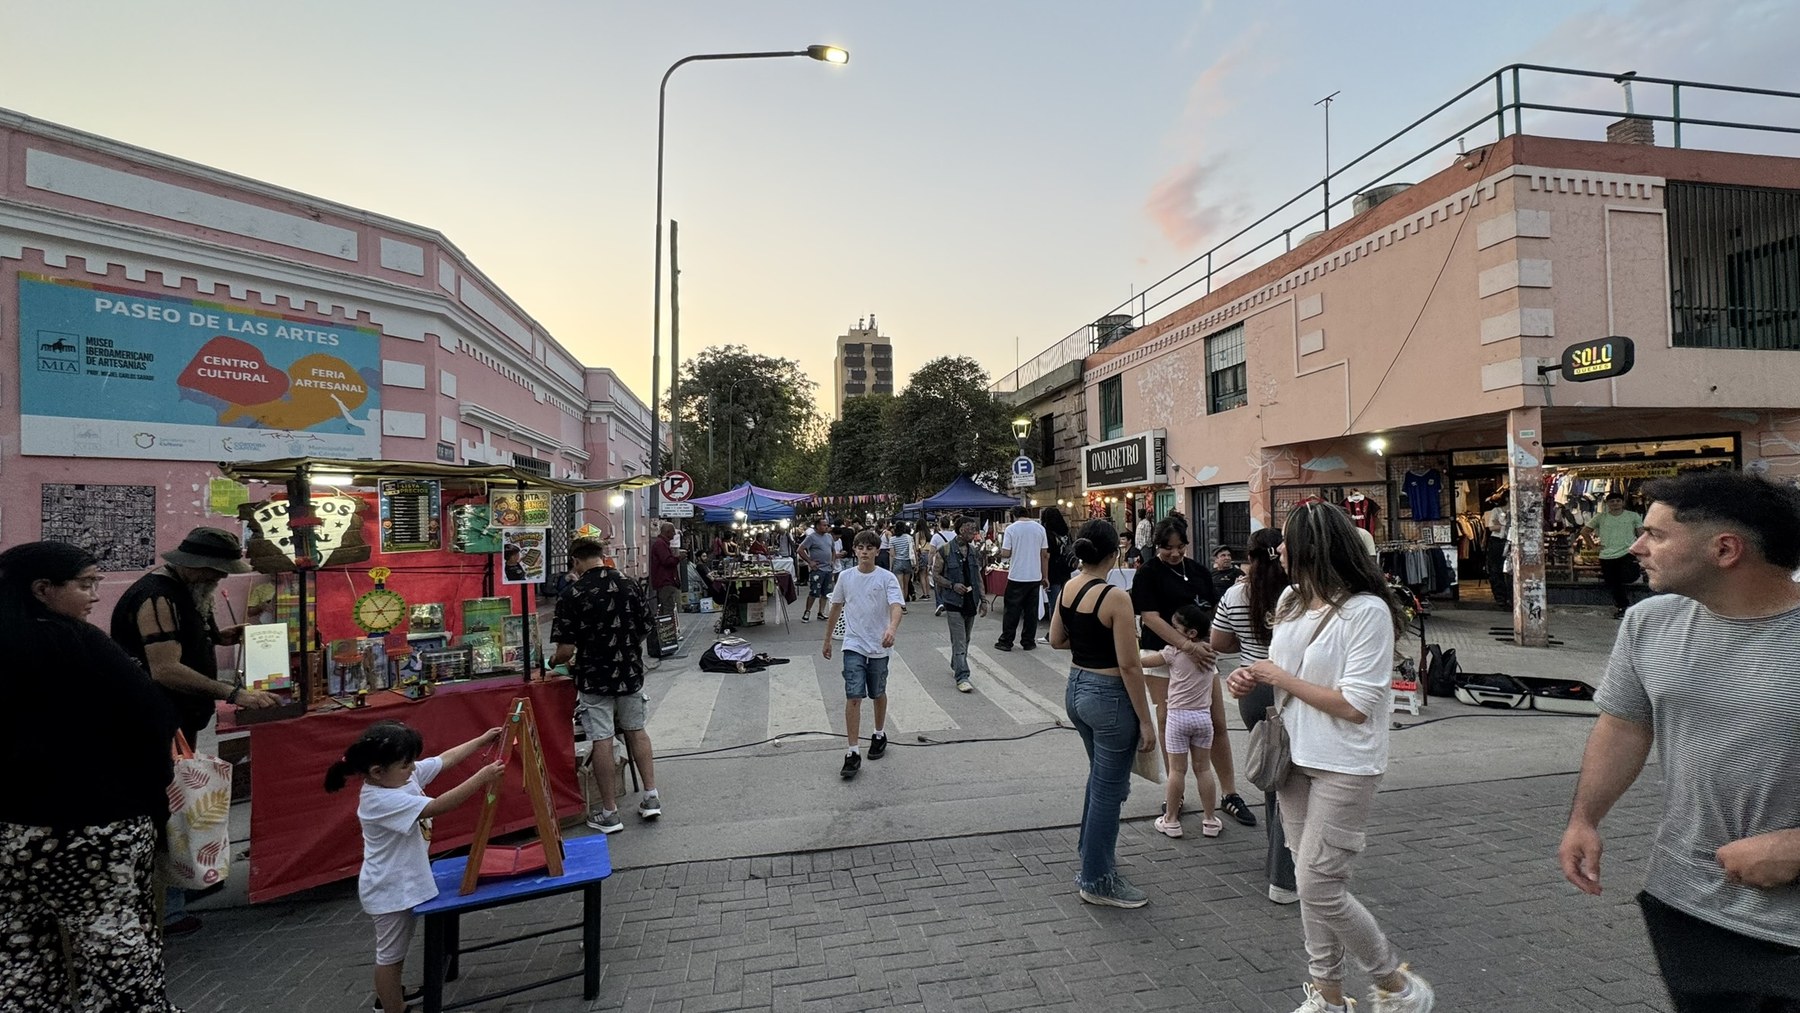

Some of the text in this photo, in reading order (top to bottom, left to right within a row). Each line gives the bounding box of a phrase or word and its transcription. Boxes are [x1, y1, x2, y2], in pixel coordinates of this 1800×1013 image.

[95, 297, 340, 346] PASEO DE LAS ARTES
[86, 336, 114, 348] MUSEO
[86, 346, 154, 362] IBEROAMERICANO
[86, 356, 97, 366] DE
[1571, 343, 1613, 367] SOLO
[41, 360, 78, 372] MIA
[203, 355, 260, 370] CENTRO
[197, 367, 270, 383] CULTURAL
[311, 368, 346, 380] FERIA
[294, 378, 366, 393] ARTESANAL
[1091, 443, 1140, 472] ONDARETRO
[1018, 460, 1029, 475] E
[515, 493, 540, 502] QUITA
[259, 499, 352, 523] JUOS
